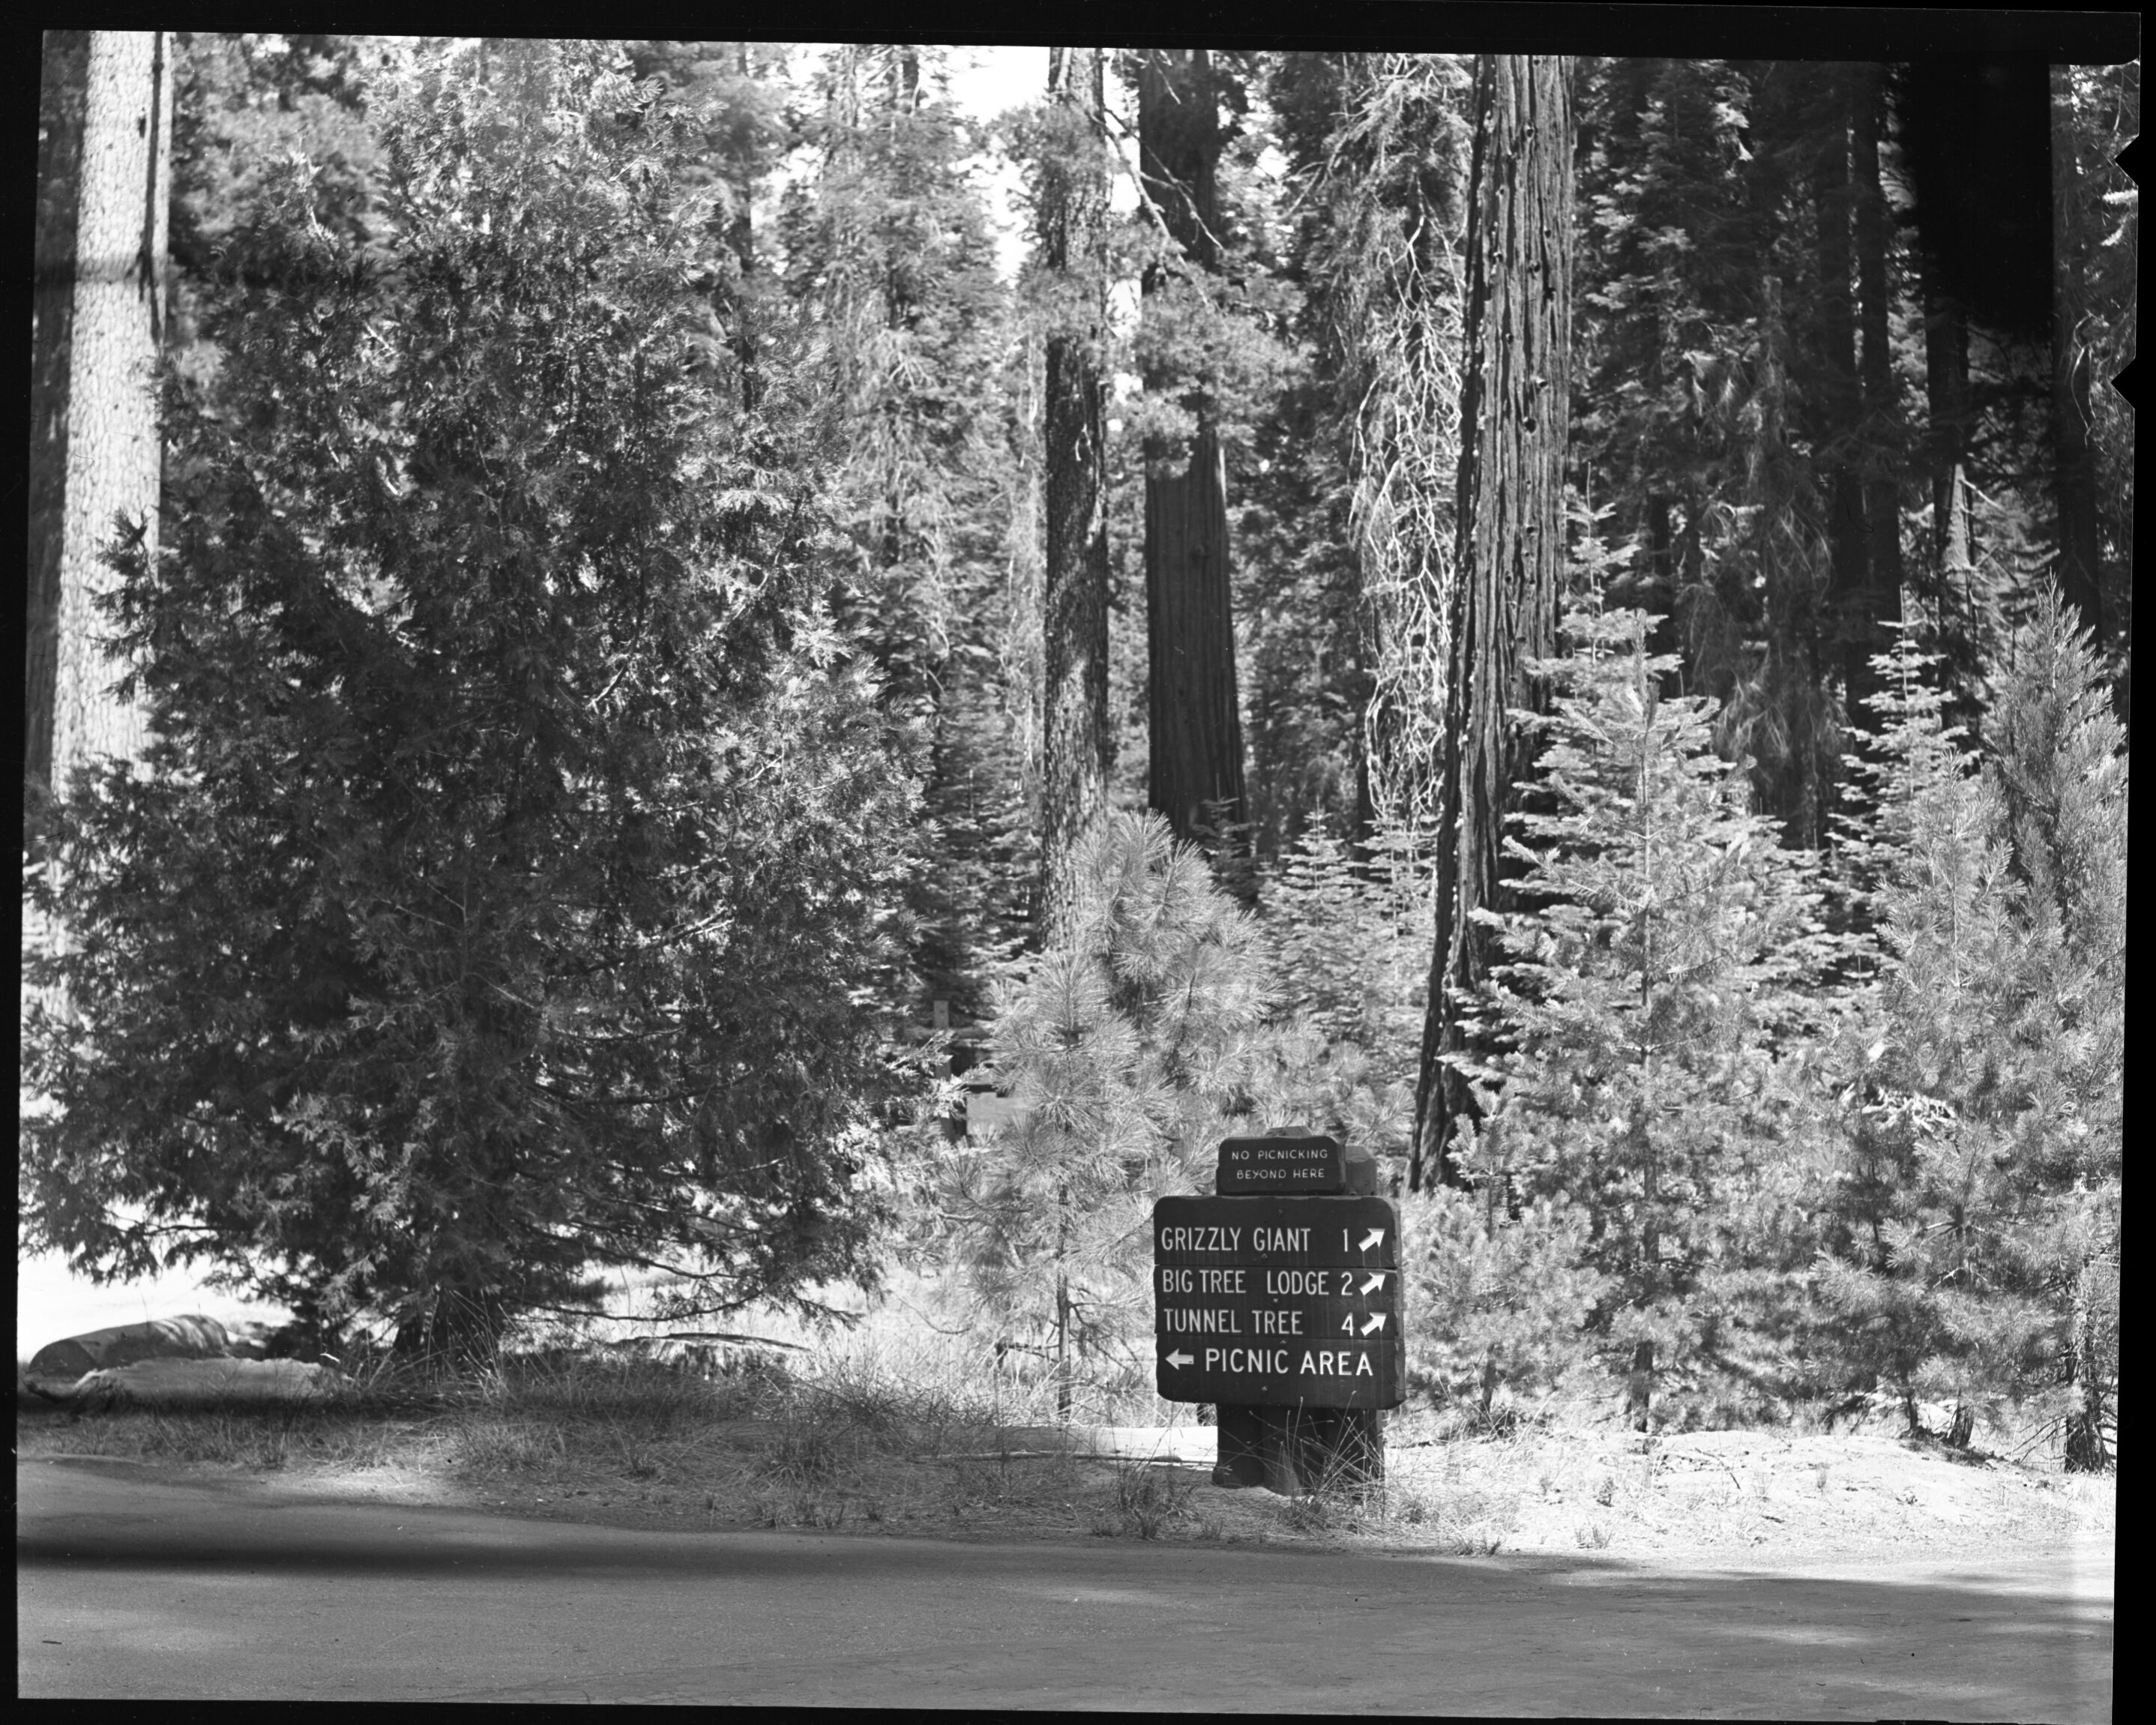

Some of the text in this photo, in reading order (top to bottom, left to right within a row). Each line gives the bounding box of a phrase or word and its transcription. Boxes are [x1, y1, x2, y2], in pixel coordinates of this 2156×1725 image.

[1232, 1150, 1328, 1160] NO PICNICKING
[1237, 1169, 1325, 1179] BEYOND HERE
[1161, 1227, 1349, 1252] GRIZZLY GIANT 1
[1163, 1269, 1353, 1295] BIG TREE LODGE 2
[1163, 1308, 1354, 1336] TUNNEL TREE 4
[1205, 1348, 1373, 1376] PICNIC AREA
